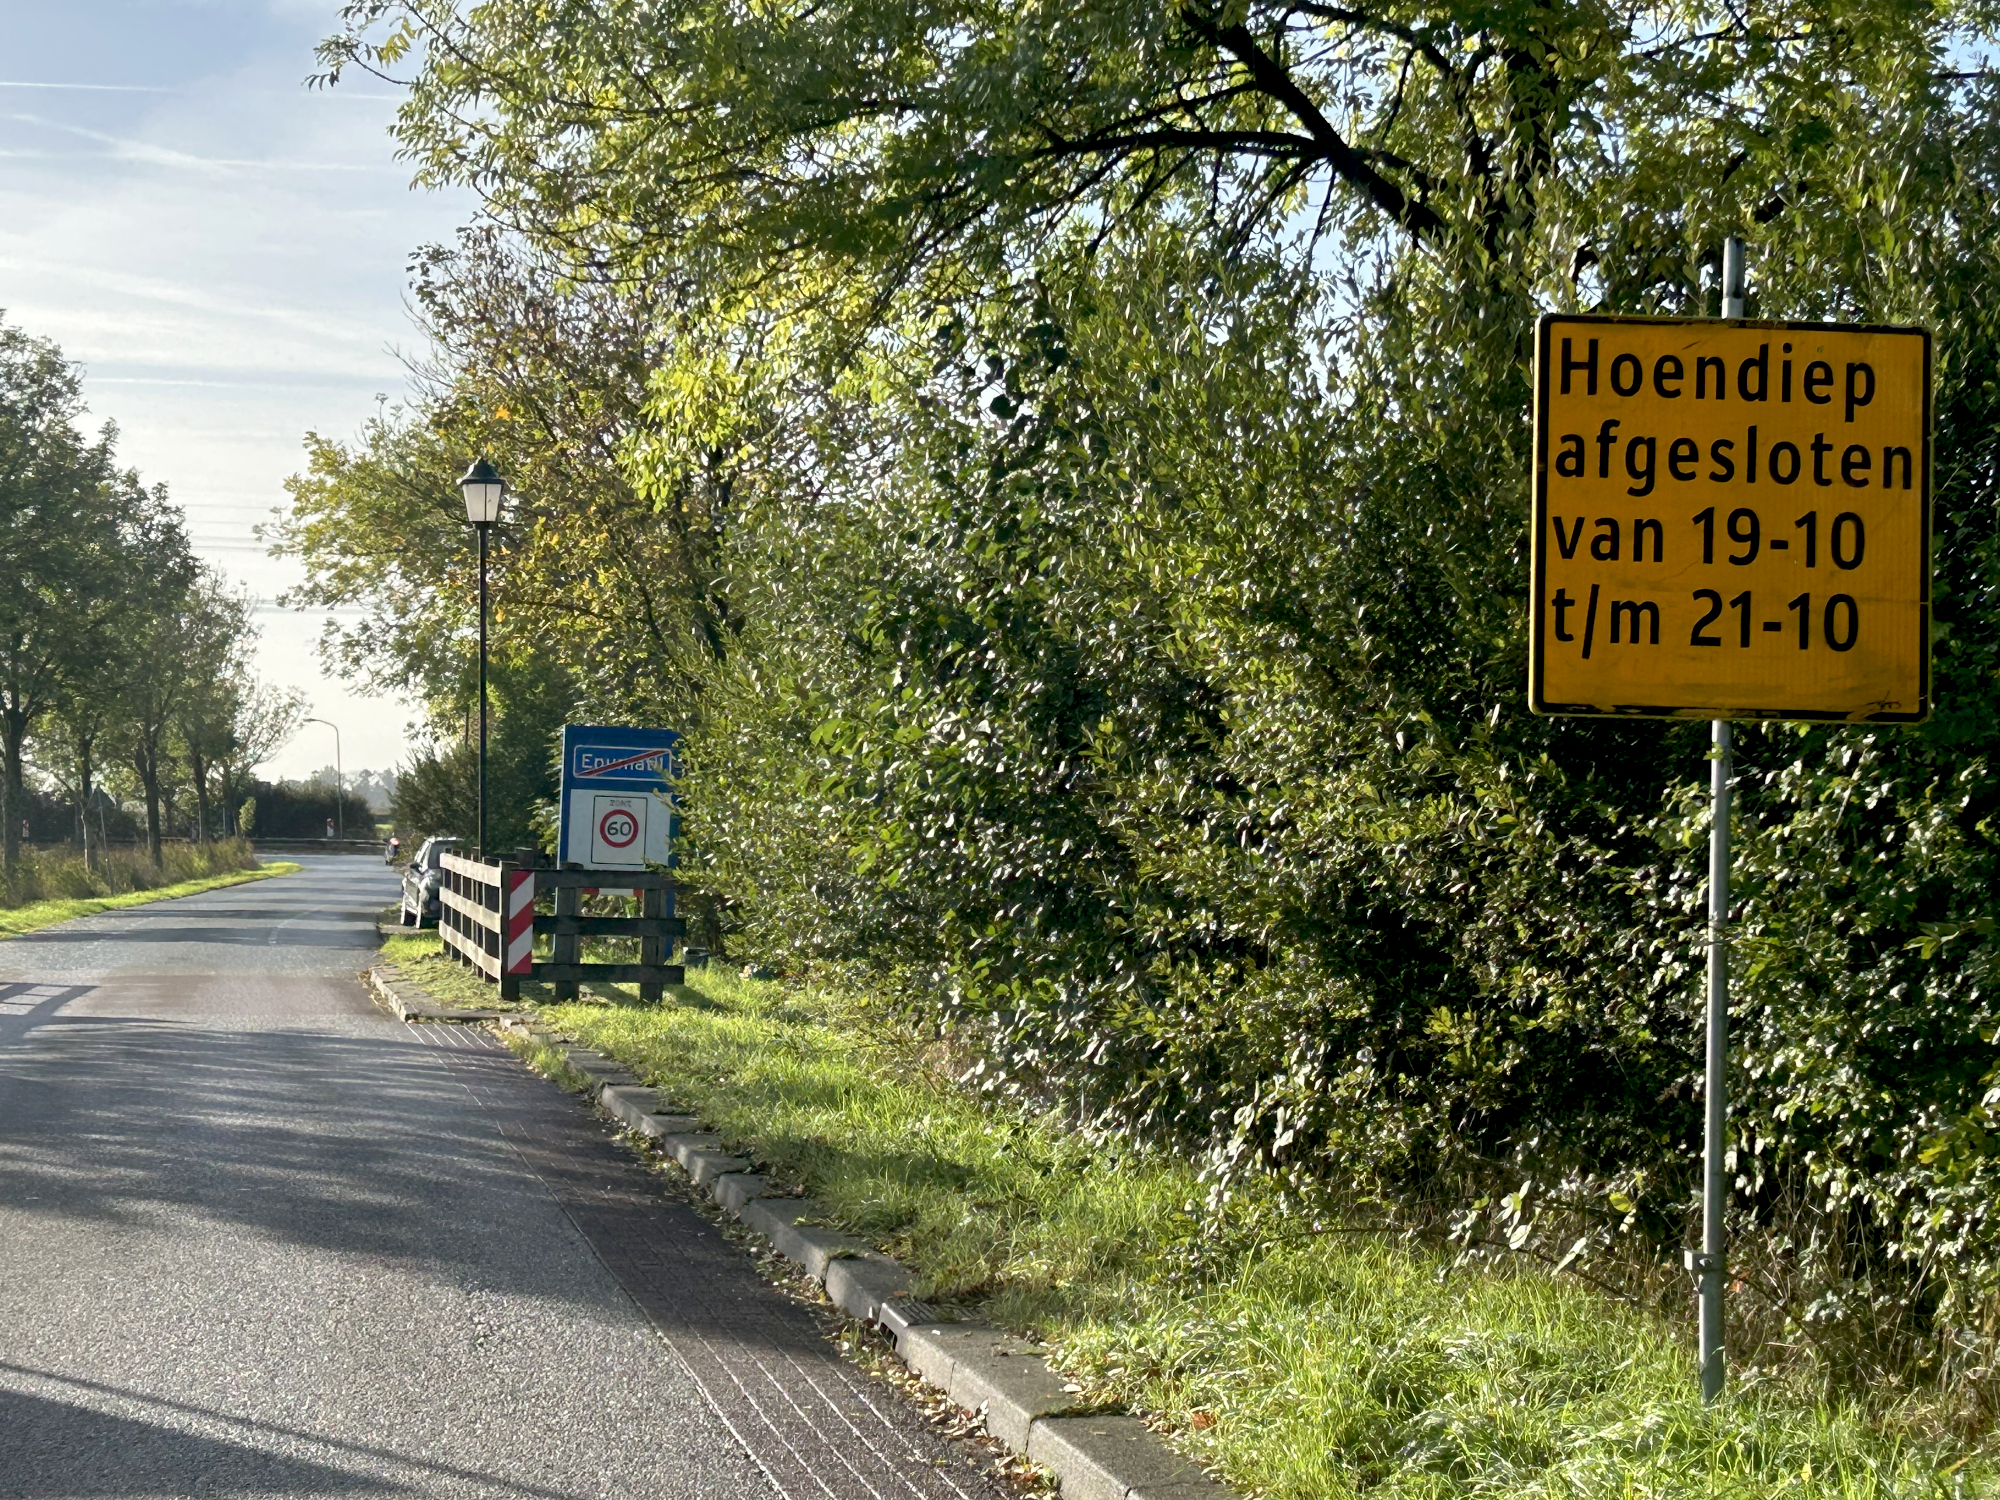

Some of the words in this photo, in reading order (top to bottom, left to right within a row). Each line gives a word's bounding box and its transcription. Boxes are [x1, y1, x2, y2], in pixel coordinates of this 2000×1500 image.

[1559, 337, 1876, 423] Hoendiep
[1554, 419, 1912, 497] afgesloten
[1552, 515, 1664, 563] van
[1692, 506, 1866, 571] 19-10
[1551, 583, 1660, 660] t/m
[1689, 588, 1859, 652] 21-10
[607, 821, 632, 836] 60
